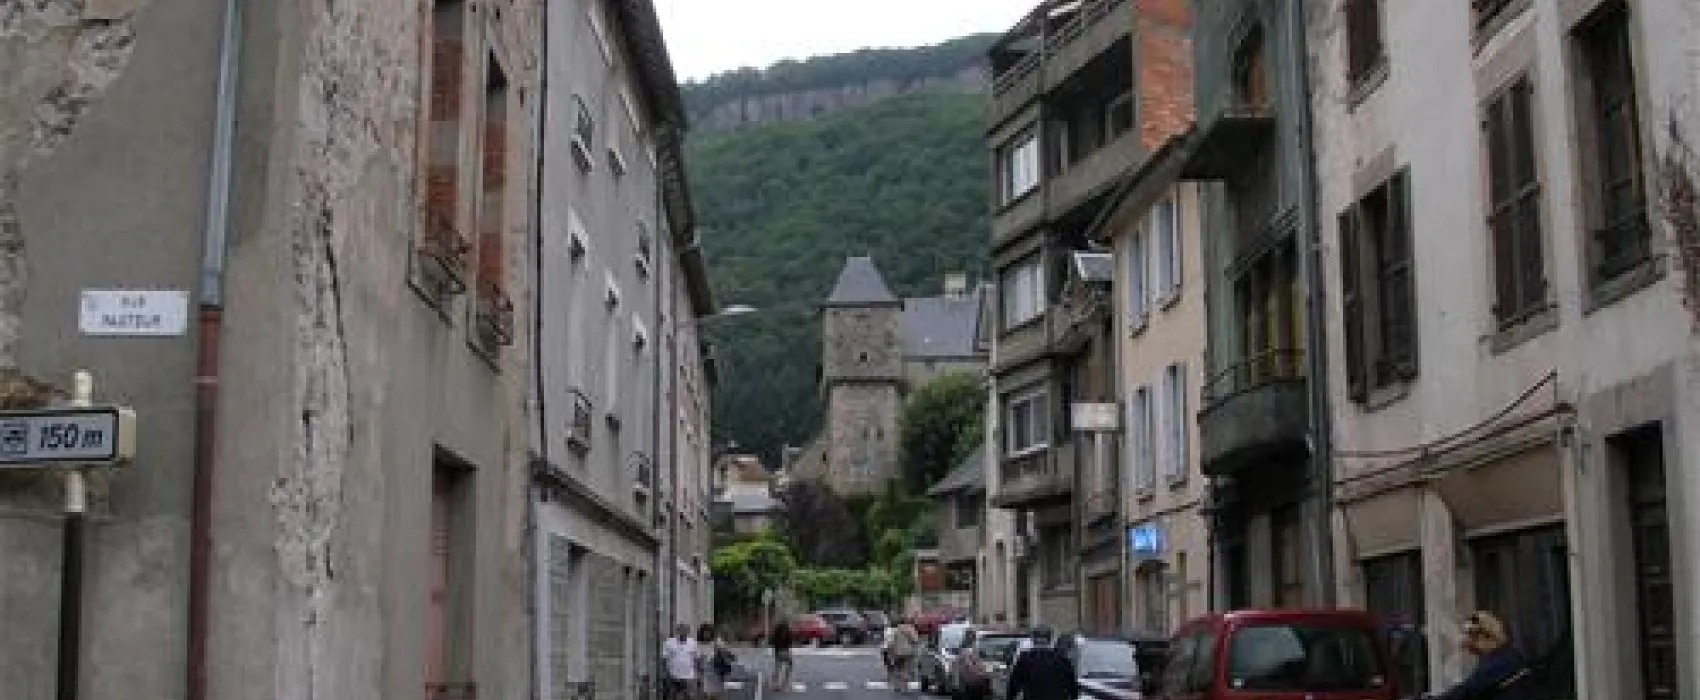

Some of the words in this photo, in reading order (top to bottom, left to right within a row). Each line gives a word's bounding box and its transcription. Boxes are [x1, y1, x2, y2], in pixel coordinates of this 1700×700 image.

[101, 313, 162, 329] PASTEUR
[39, 423, 79, 448] 150
[81, 429, 103, 448] m
